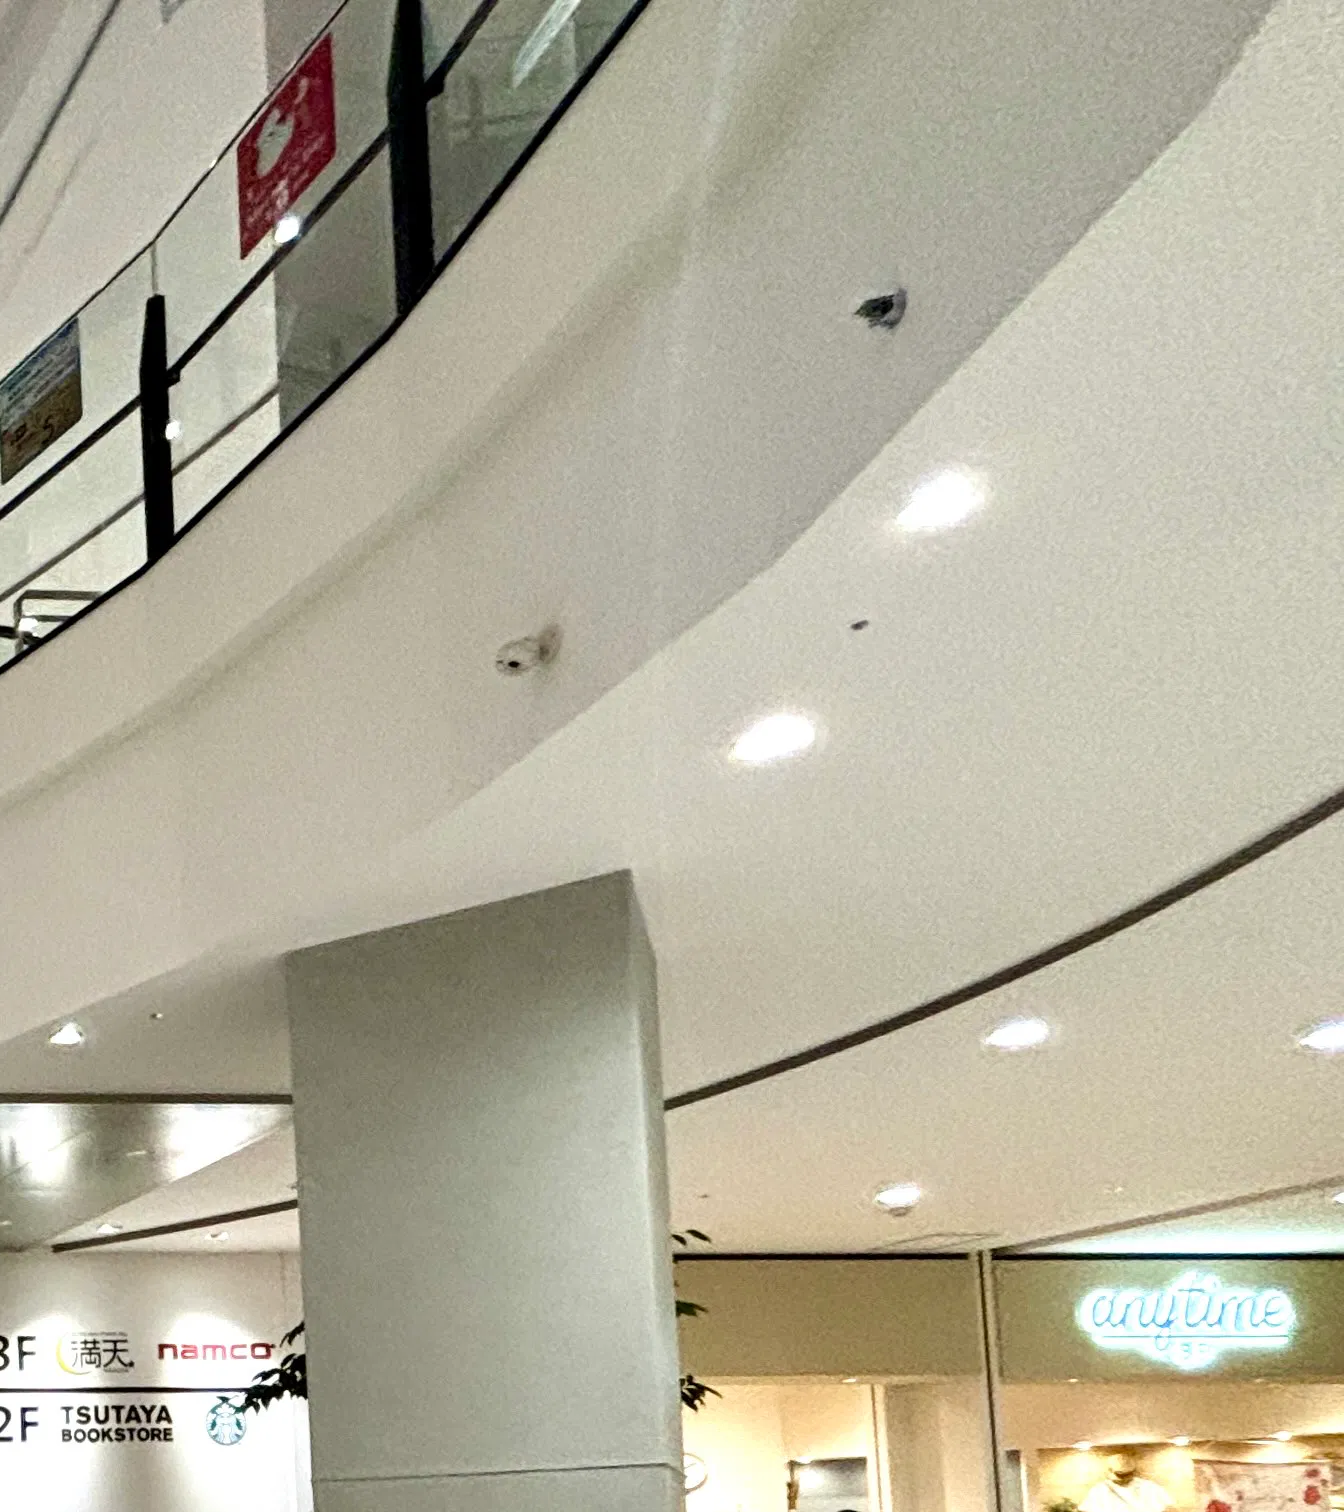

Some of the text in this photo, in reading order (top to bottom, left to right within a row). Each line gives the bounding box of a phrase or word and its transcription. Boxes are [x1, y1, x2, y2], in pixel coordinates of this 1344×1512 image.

[1090, 1273, 1288, 1352] anytime
[70, 1338, 134, 1368] 満天
[158, 1342, 274, 1361] namco
[60, 1404, 173, 1425] TSUTAYA
[61, 1427, 174, 1443] BOOKSTORE
